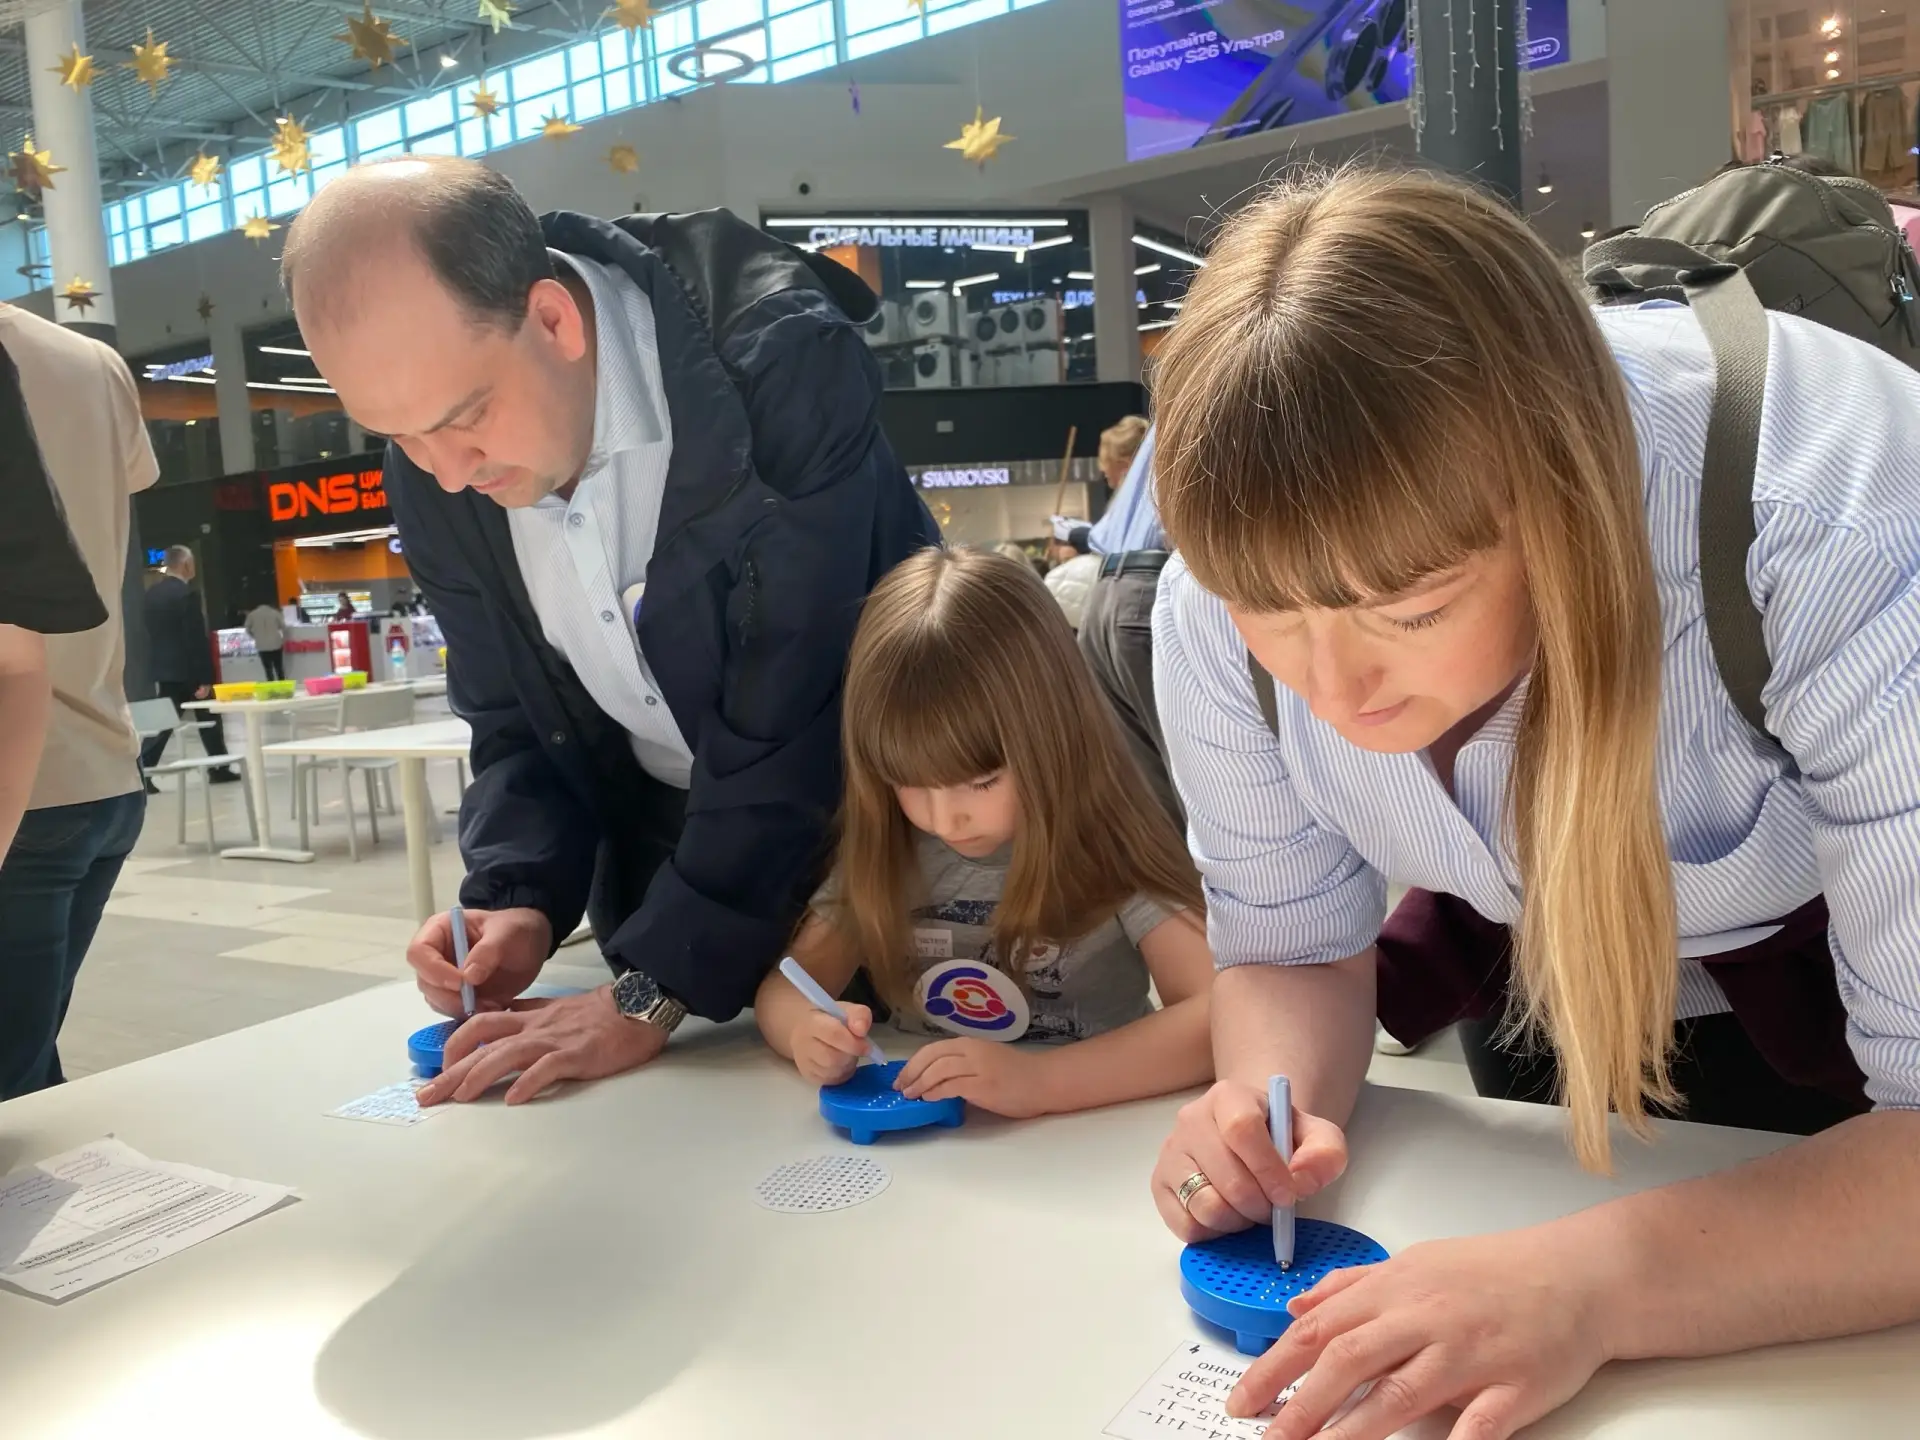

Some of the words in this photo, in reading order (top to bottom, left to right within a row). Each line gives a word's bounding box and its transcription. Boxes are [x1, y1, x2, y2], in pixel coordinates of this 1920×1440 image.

[1127, 30, 1218, 62] Покупайте
[1128, 55, 1183, 78] Galaxy
[1184, 44, 1219, 64] S26
[1221, 29, 1285, 54] Ультра
[809, 226, 937, 247] СТИРАЛЬНЫЕ
[940, 227, 1034, 247] МАШИНЫ
[922, 468, 1009, 488] SWAROVSKI
[269, 473, 358, 521] DNS
[1178, 1370, 1222, 1389] узор
